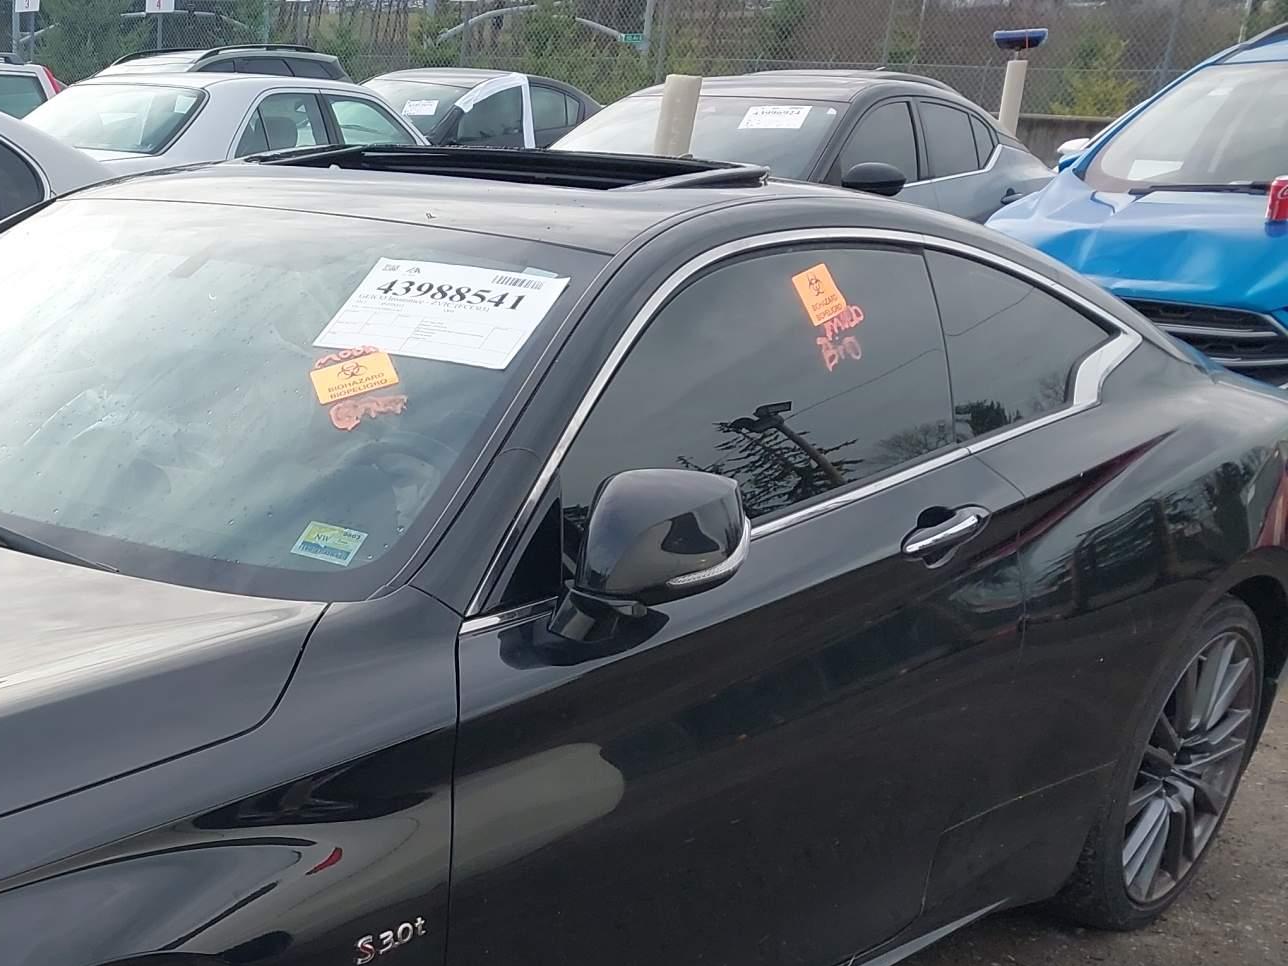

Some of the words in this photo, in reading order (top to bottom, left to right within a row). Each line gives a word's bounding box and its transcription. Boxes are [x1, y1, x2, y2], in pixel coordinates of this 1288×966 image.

[376, 279, 527, 311] 43988541
[328, 372, 385, 393] BIOHAZARD
[329, 379, 388, 400] BIOPELIGRO
